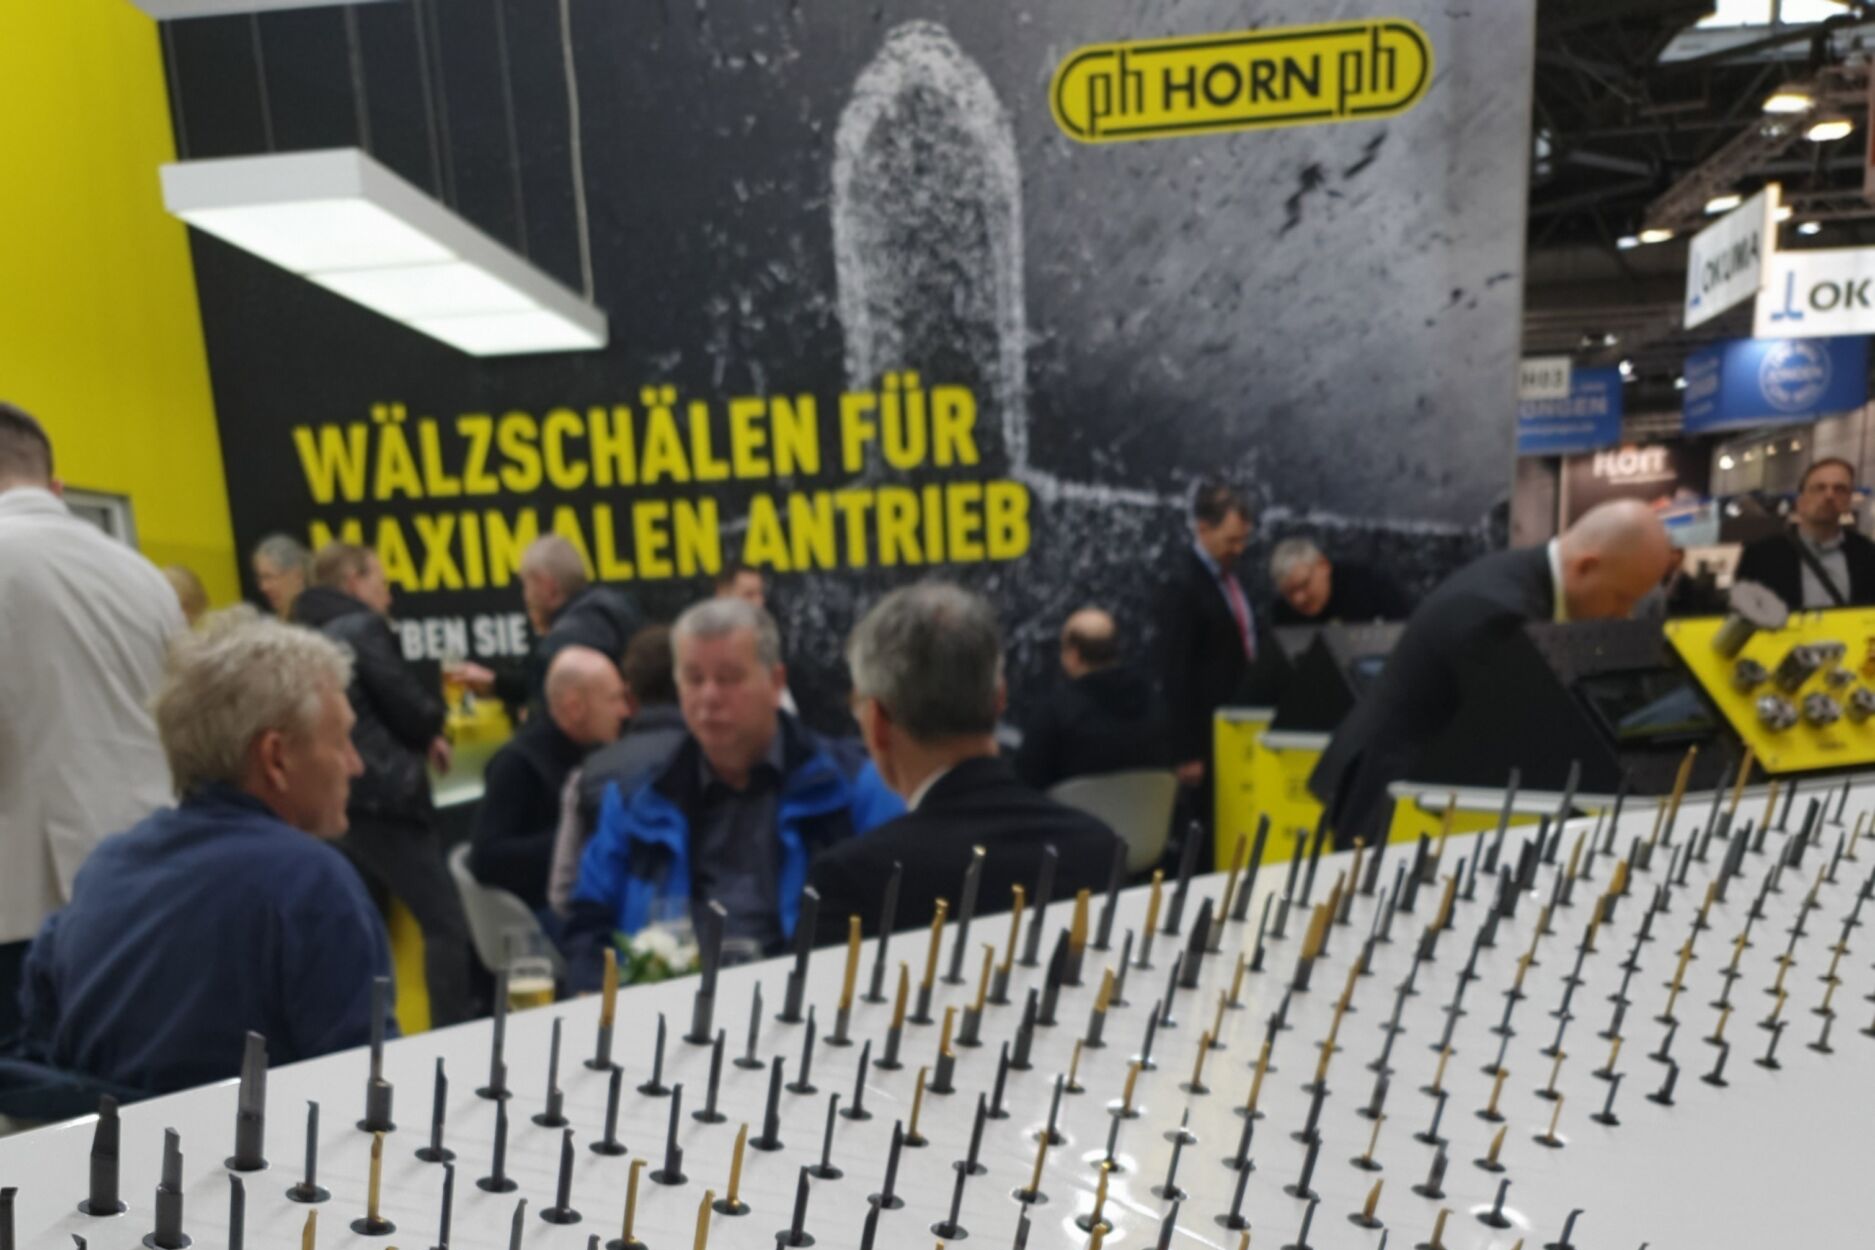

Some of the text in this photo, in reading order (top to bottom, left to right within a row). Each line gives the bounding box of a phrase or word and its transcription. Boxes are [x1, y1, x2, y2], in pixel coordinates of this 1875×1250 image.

[1161, 53, 1323, 112] HORN
[291, 369, 980, 504] WÄLZSCHÄLEN FÜR
[742, 478, 1031, 574] ANTRIEB
[389, 611, 530, 661] BEN SIE
